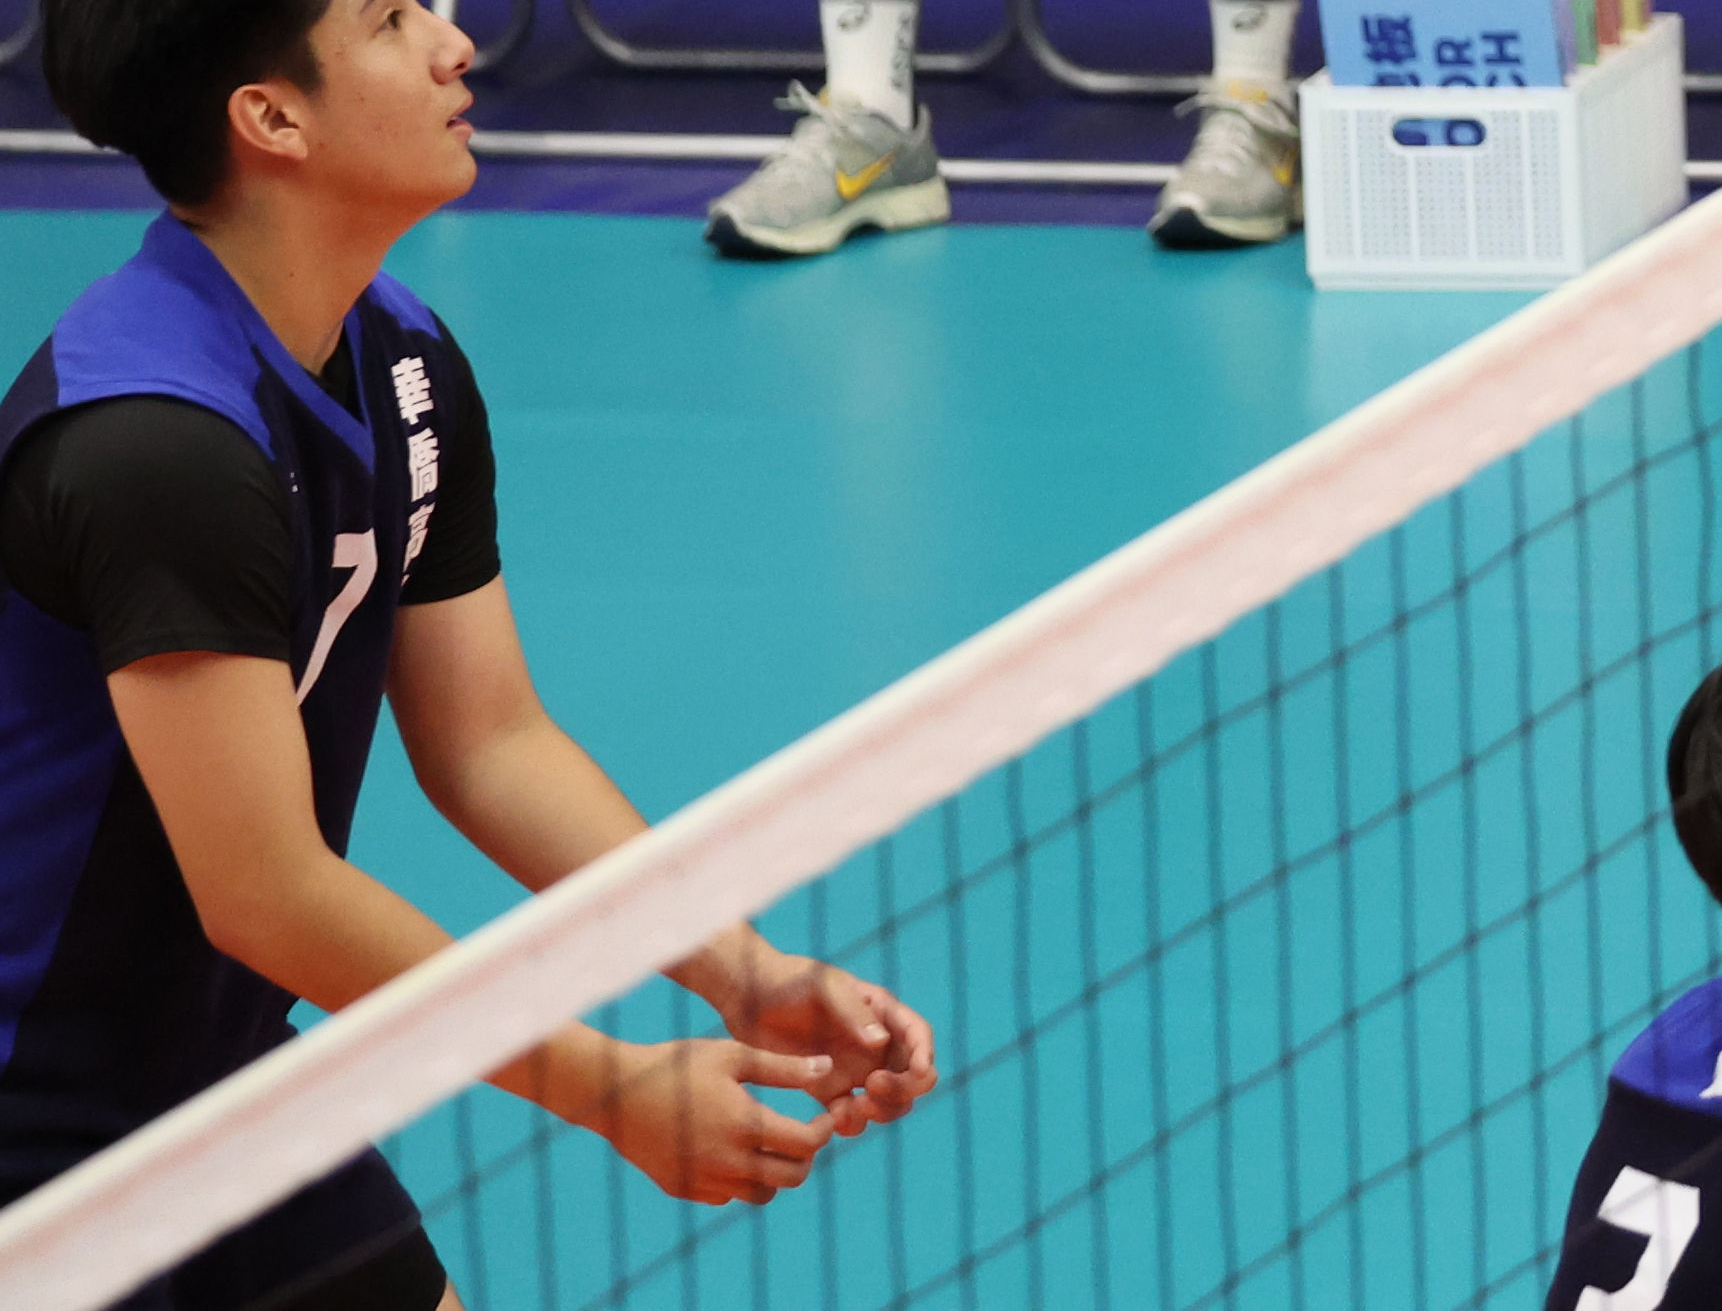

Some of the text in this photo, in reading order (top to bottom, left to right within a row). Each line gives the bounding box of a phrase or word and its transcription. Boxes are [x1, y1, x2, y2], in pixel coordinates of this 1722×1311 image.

[391, 356, 440, 586] 華僑高
[296, 527, 378, 706] 7
